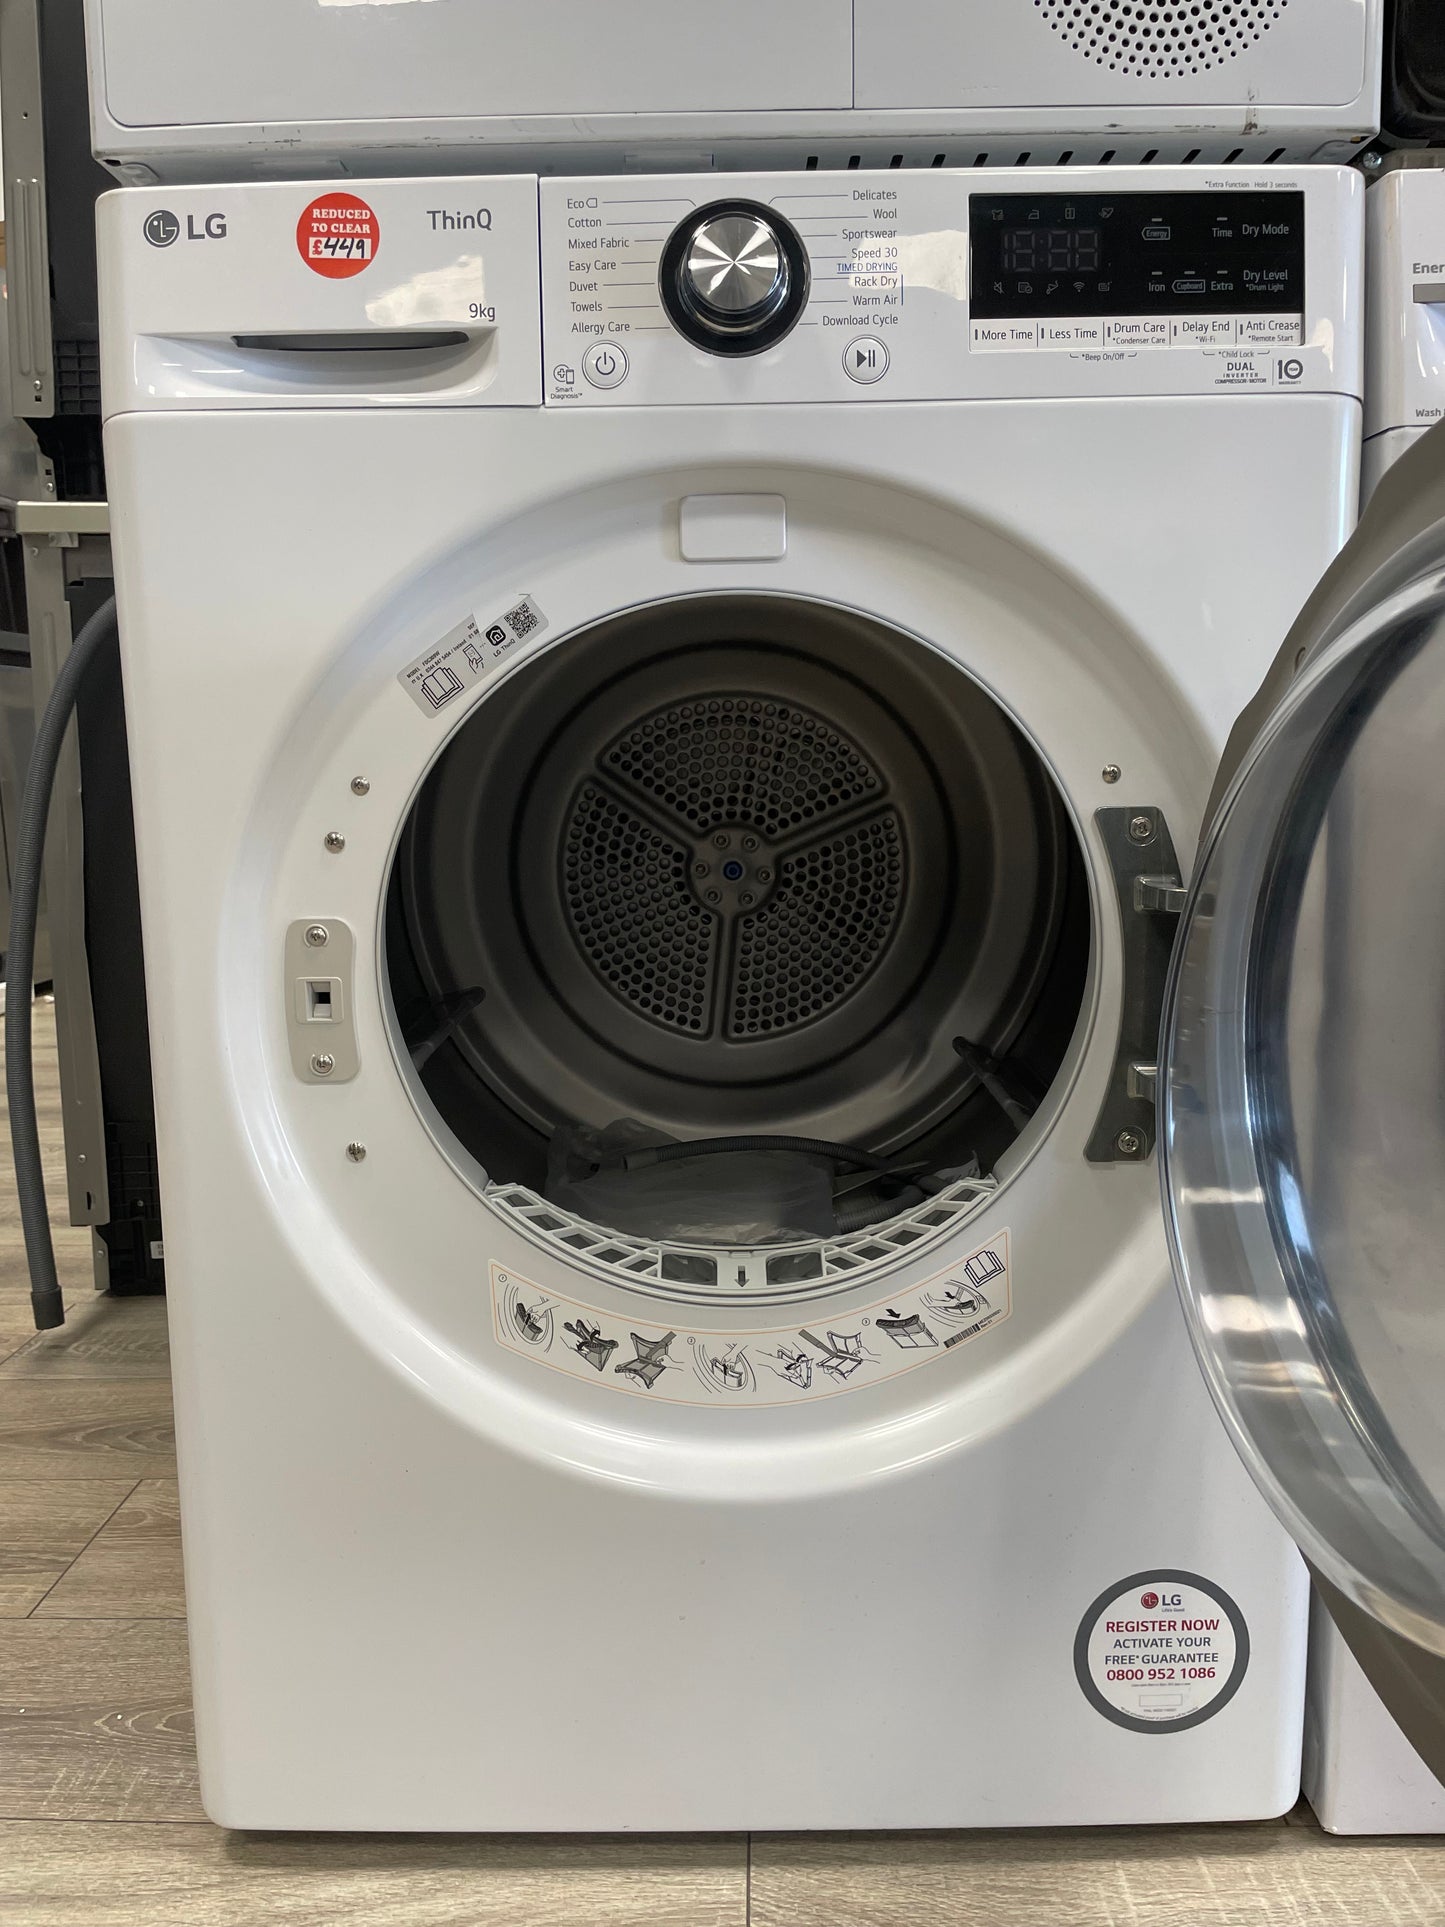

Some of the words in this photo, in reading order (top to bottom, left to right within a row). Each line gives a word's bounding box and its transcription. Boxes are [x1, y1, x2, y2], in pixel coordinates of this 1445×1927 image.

[852, 190, 897, 201] Delicates
[567, 198, 584, 210] Eco
[312, 208, 370, 220] REDUCED
[426, 208, 492, 232] ThinQ
[873, 208, 897, 220] Wool
[187, 213, 228, 240] LG
[312, 222, 328, 232] TO
[331, 224, 370, 234] CLEAR
[568, 216, 602, 228] Cotton
[842, 228, 897, 241] Sportswear
[1146, 230, 1168, 238] Energy
[1212, 227, 1232, 238] Time
[1242, 224, 1260, 238] Dry
[1262, 224, 1289, 235] Mode
[312, 236, 365, 258] £449
[568, 238, 596, 250] Mixed
[600, 237, 630, 248] Fabric
[852, 248, 882, 261] Speed
[884, 247, 898, 258] 30
[570, 260, 591, 273] Easy
[594, 260, 616, 271] Care
[837, 262, 864, 272] TIMED
[866, 262, 898, 272] DRYING
[1243, 270, 1260, 284] Dry
[1264, 269, 1288, 281] Level
[570, 281, 598, 292] Duvet
[855, 276, 877, 288] Rack
[880, 276, 898, 290] Dry
[1148, 282, 1166, 292] Iron
[1176, 282, 1203, 291] Cupboard
[1210, 281, 1234, 290] Extra
[1268, 282, 1284, 292] Light
[852, 296, 880, 306] Warm
[883, 294, 898, 306] Air
[468, 303, 496, 322] 9kg
[571, 301, 602, 312] Towels
[822, 315, 870, 326] Download
[873, 314, 898, 328] Cycle
[1246, 320, 1266, 331] Anti
[1268, 320, 1300, 331] Crease
[572, 322, 604, 335] Allergy
[608, 321, 630, 332] Care
[1114, 322, 1140, 334] Drum
[1143, 322, 1166, 332] Care
[1182, 322, 1207, 334] Delay
[1210, 321, 1230, 332] End
[982, 329, 1006, 341] More
[1010, 328, 1033, 340] Time
[1049, 328, 1070, 340] Less
[1074, 328, 1098, 340] Time
[1152, 336, 1166, 344] Care
[1102, 352, 1124, 362] On/Off
[1227, 362, 1254, 371] DUAL
[1416, 408, 1441, 417] Wash
[454, 639, 467, 652] Ireland
[493, 649, 502, 658] LG
[502, 638, 516, 652] ThinQ
[406, 666, 421, 679] MODEL
[1162, 1594, 1182, 1606] LG
[1106, 1620, 1177, 1633] REGISTER
[1181, 1619, 1220, 1632] NOW
[1114, 1638, 1173, 1649] ACTIVATE
[1176, 1637, 1211, 1647] YOUR
[1141, 1653, 1219, 1664] GUARANTEE
[1106, 1670, 1144, 1681] 0800
[1148, 1668, 1175, 1680] 952
[1180, 1667, 1216, 1679] 1086
